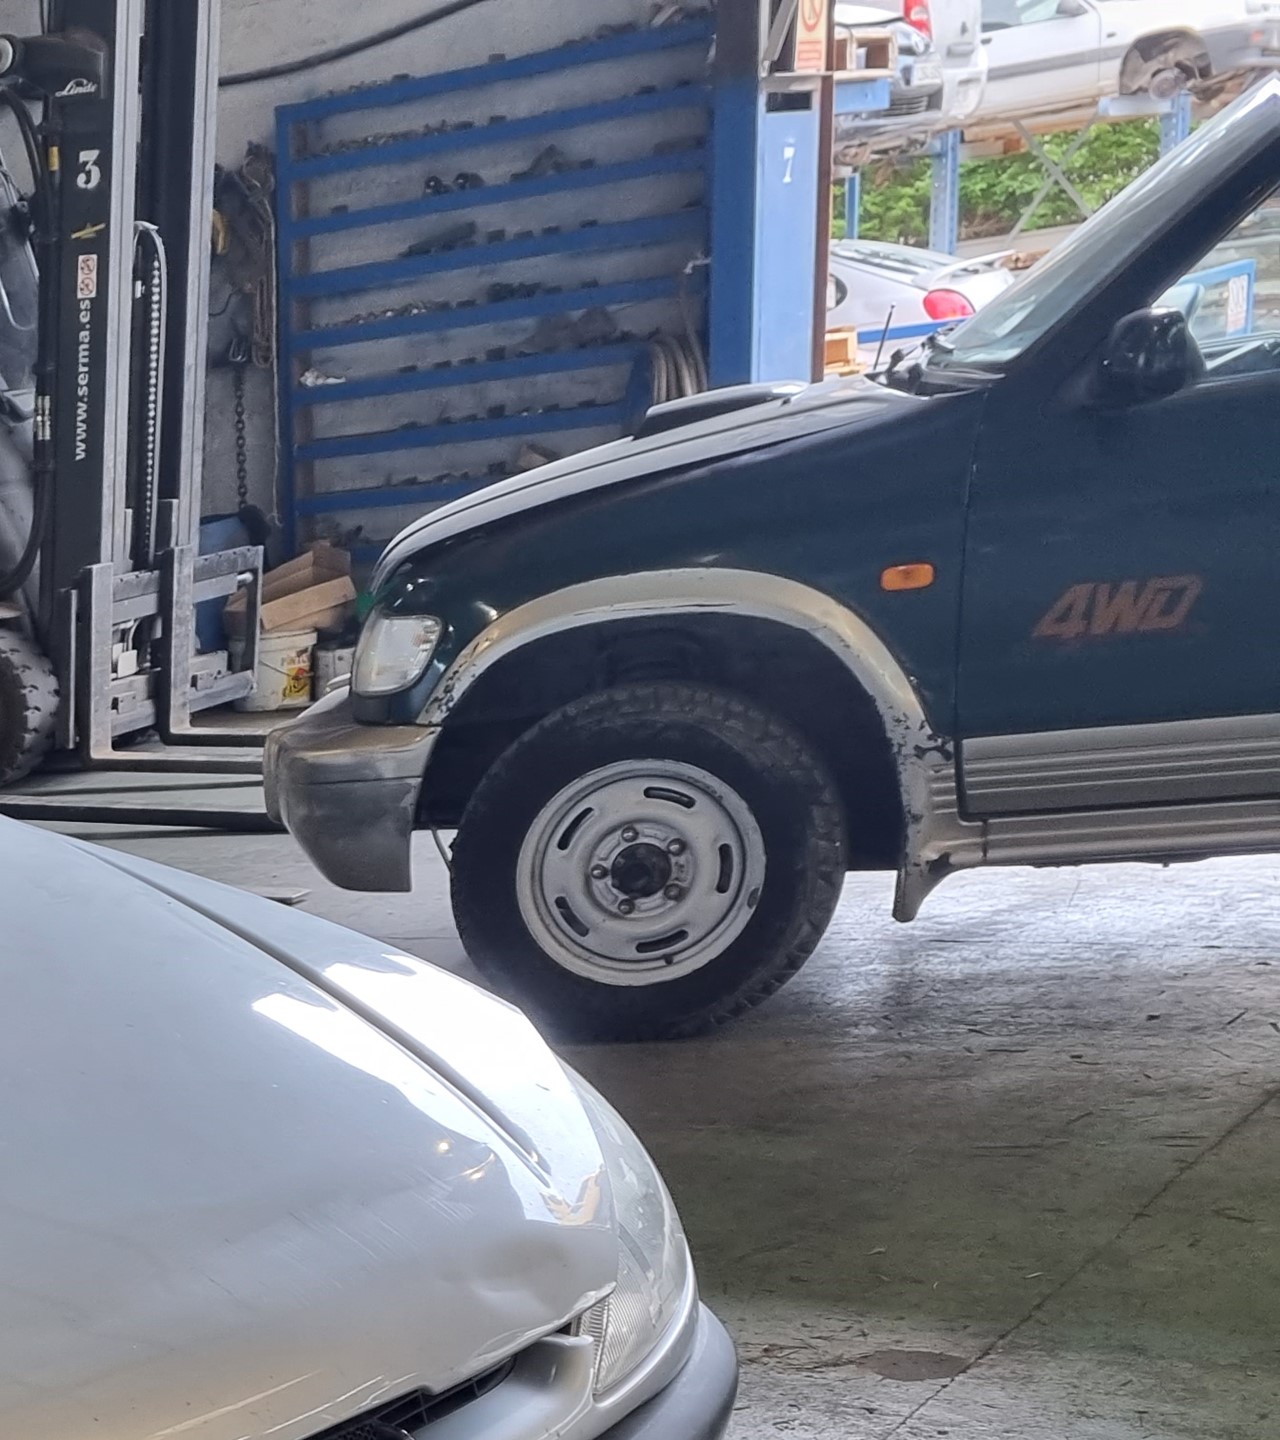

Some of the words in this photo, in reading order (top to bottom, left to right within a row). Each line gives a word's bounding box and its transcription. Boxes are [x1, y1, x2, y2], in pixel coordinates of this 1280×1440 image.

[55, 78, 98, 97] Linde
[76, 149, 101, 189] 3
[75, 299, 91, 461] www.serma.es
[1032, 574, 1203, 639] 4WD
